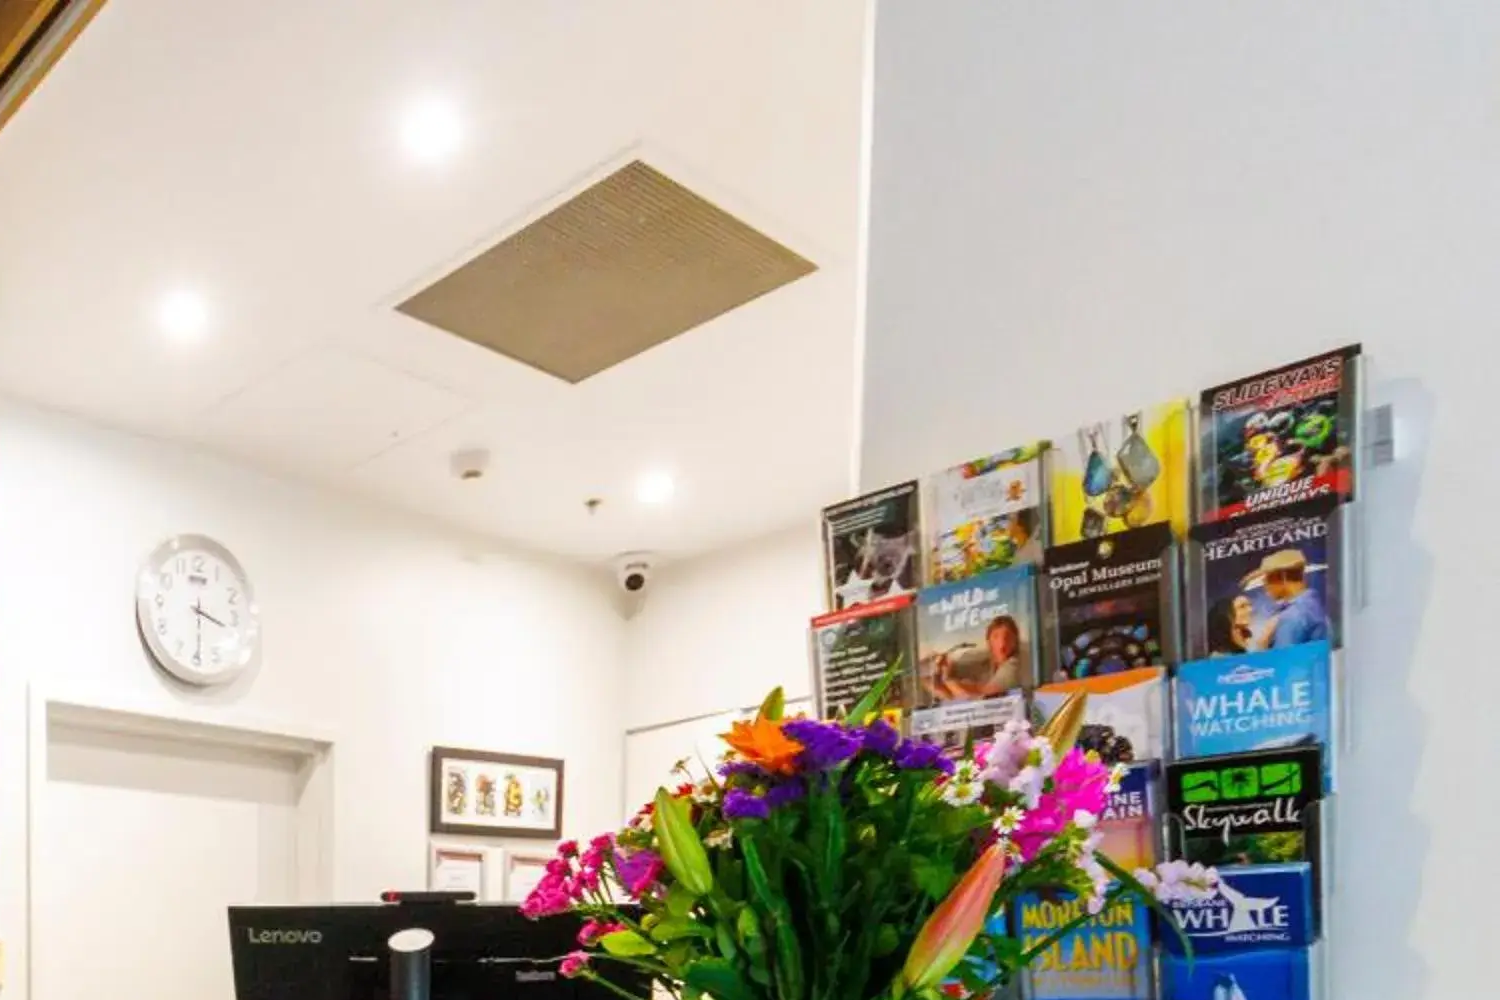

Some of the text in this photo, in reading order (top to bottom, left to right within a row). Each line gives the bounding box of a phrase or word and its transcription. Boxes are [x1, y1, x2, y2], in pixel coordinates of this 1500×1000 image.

[1245, 475, 1315, 508] UNIQUE
[1201, 521, 1330, 561] HEARTLAND
[1049, 569, 1088, 592] Opal
[1092, 557, 1163, 582] Museum
[226, 587, 239, 605] 2
[1185, 680, 1311, 721] WHALE
[1189, 709, 1317, 737] WATCHING
[1183, 796, 1301, 847] Skywalk
[247, 926, 324, 945] Lenovo
